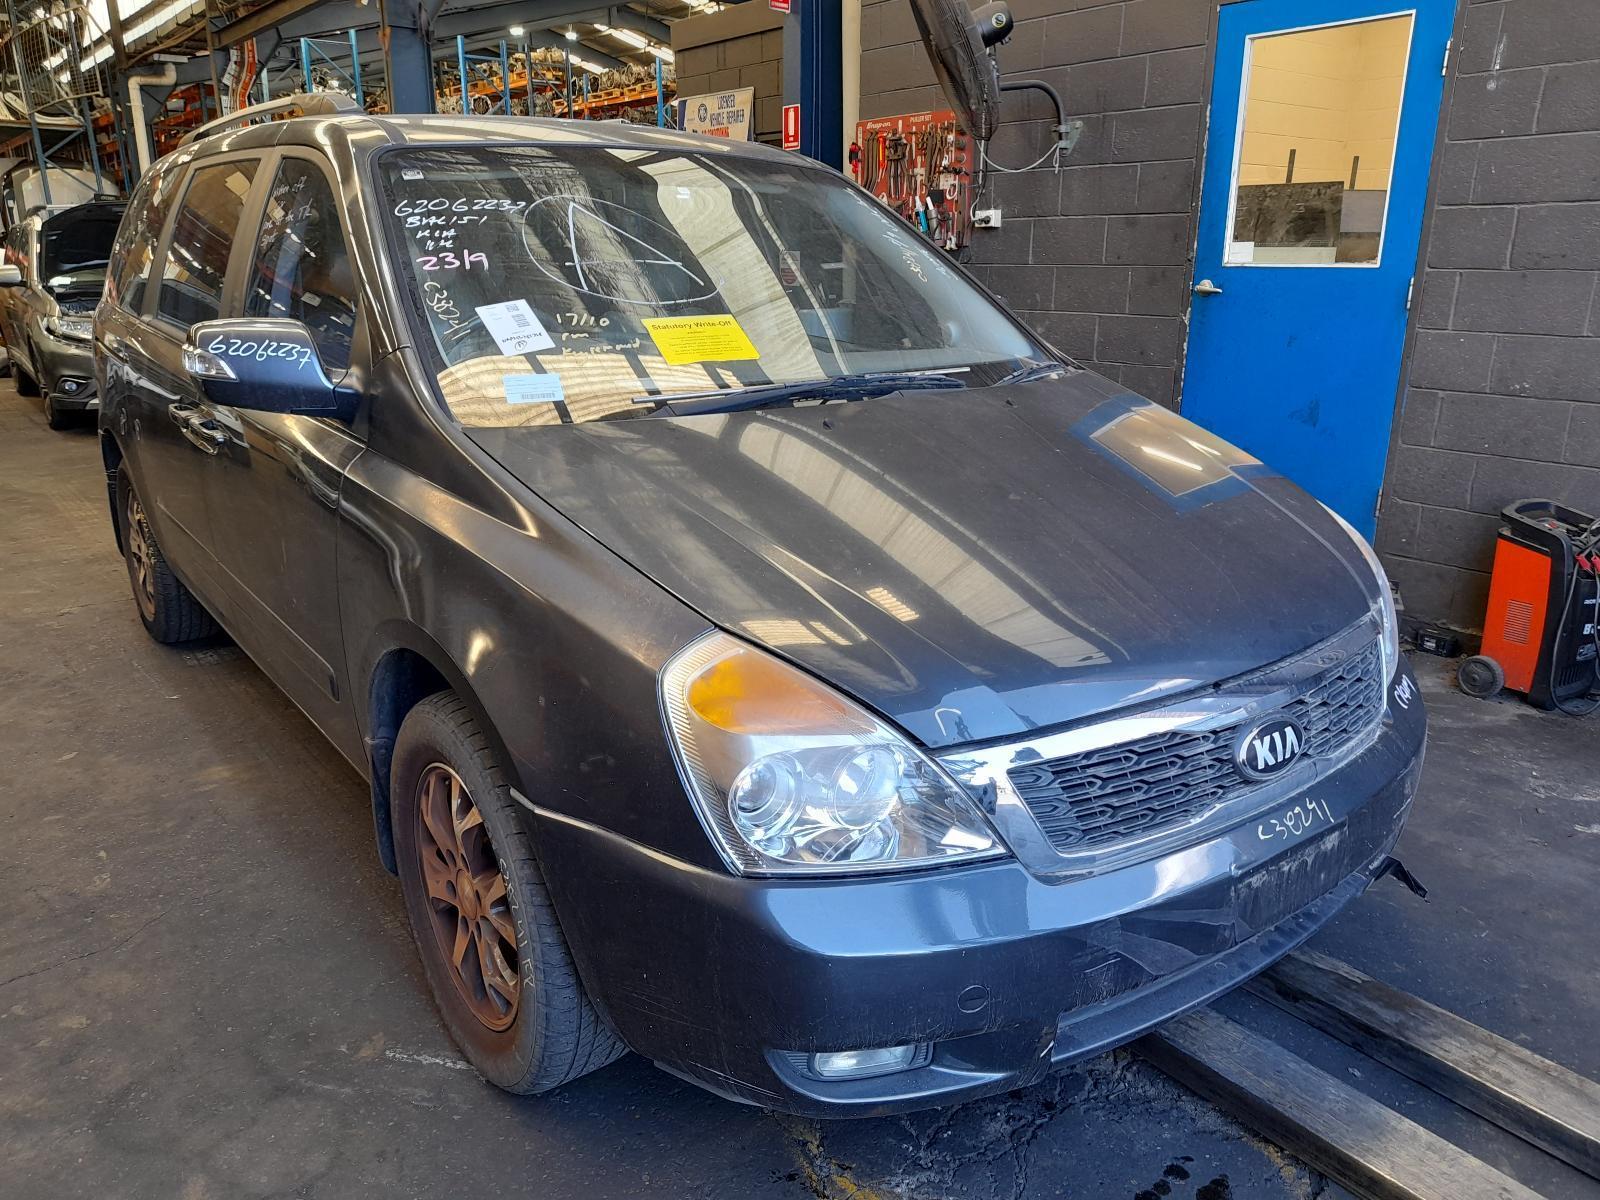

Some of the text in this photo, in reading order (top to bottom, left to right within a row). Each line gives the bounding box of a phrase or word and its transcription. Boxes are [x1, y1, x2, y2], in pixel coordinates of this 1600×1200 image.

[651, 320, 732, 330] Statutory Write-Off
[208, 334, 312, 370] 62062237
[1252, 725, 1300, 770] KIA
